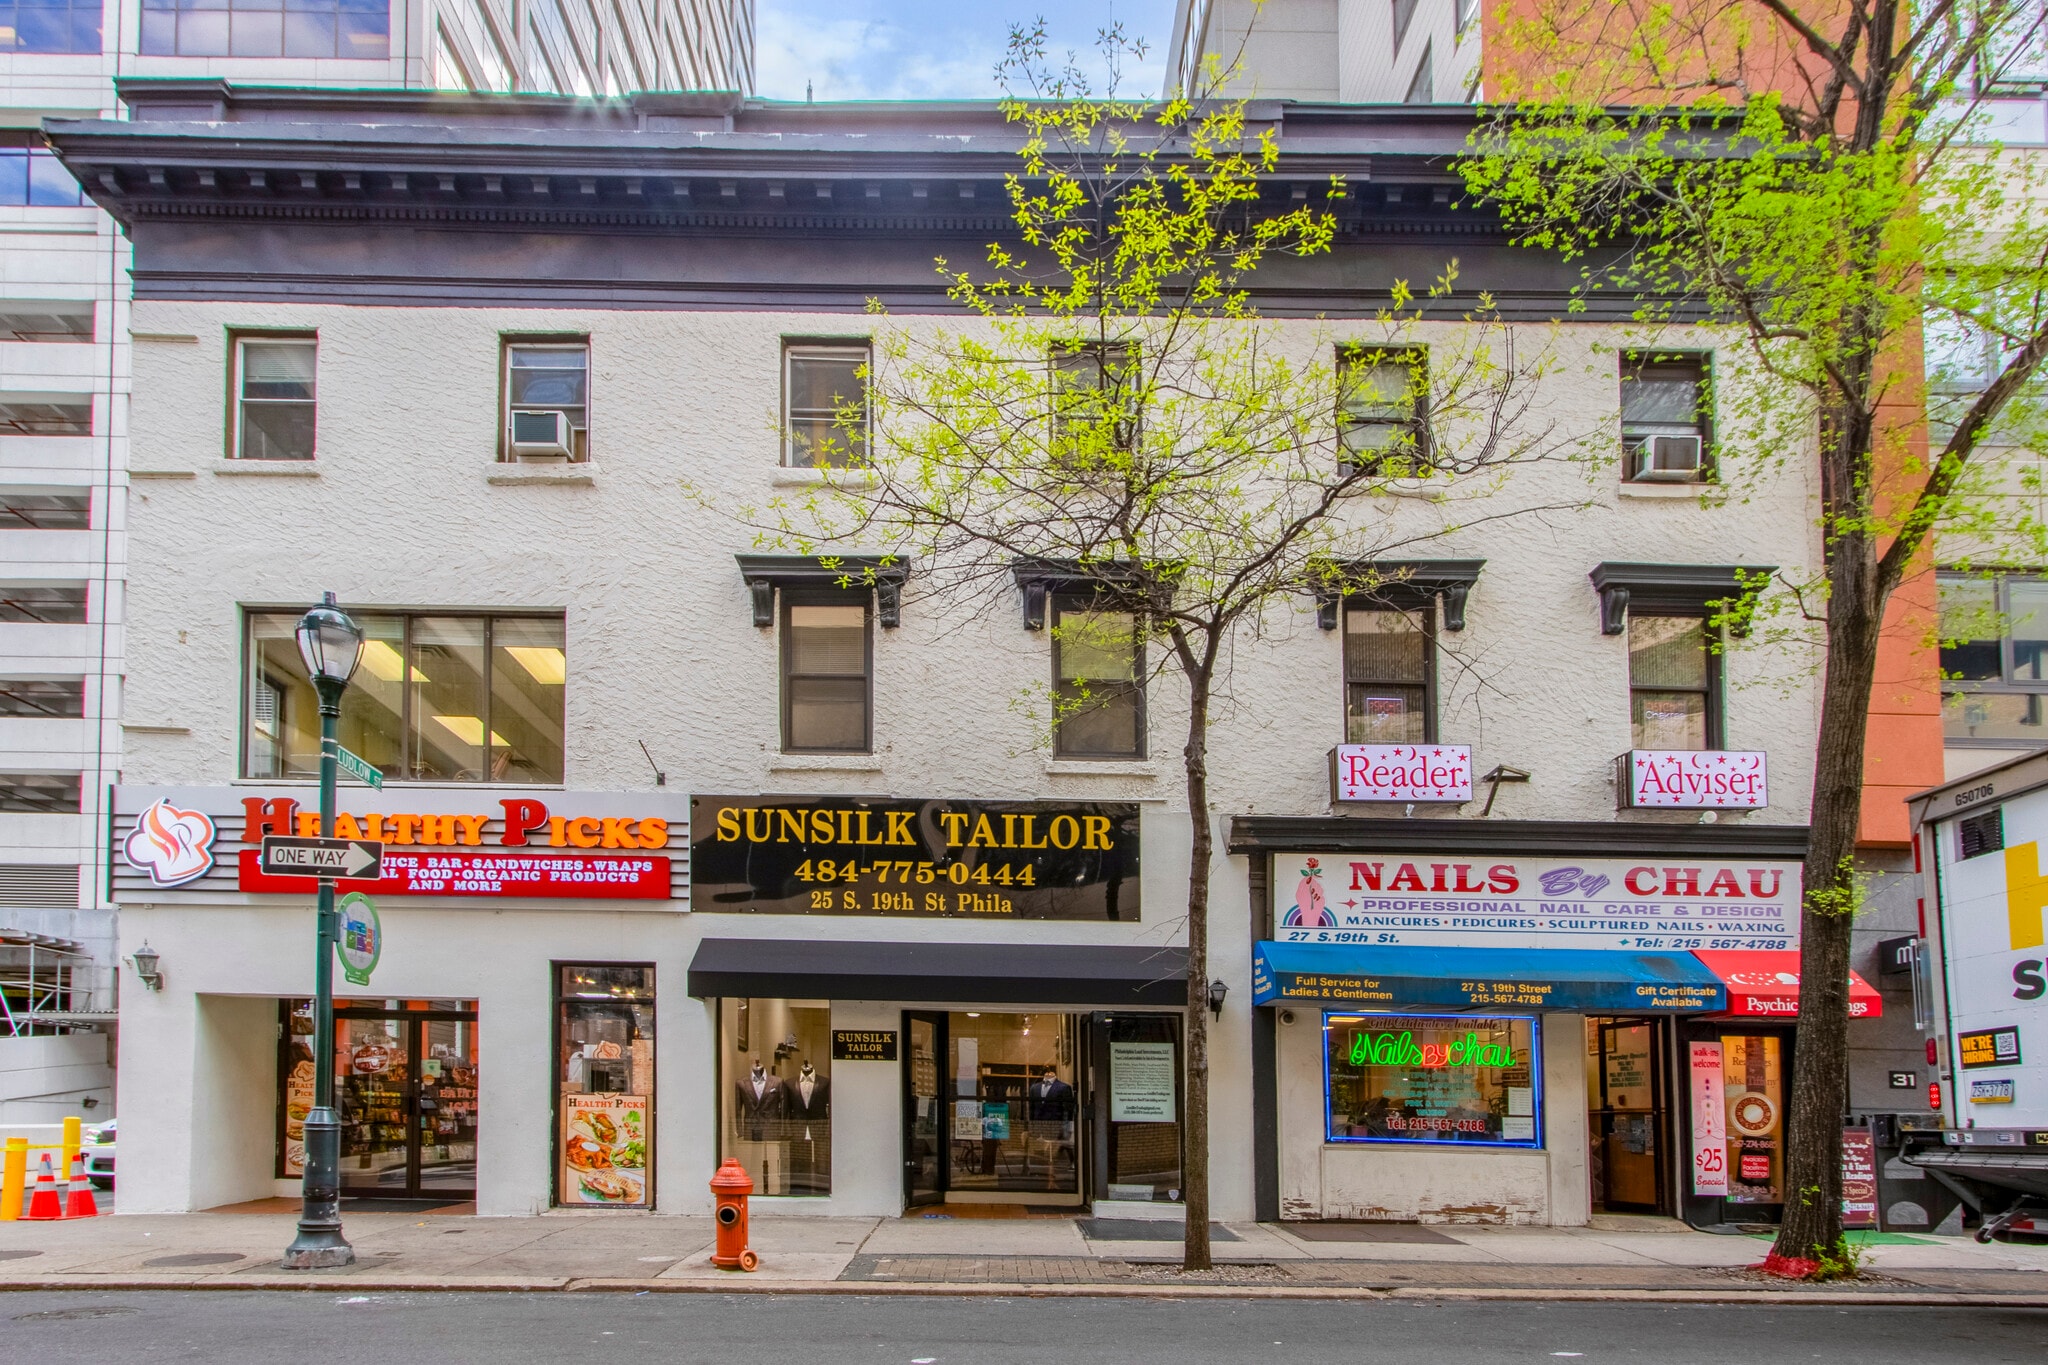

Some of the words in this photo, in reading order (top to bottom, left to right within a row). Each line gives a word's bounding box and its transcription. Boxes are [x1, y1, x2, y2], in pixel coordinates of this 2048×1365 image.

[338, 748, 370, 781] LUDLOW
[373, 776, 381, 788] ST
[1347, 755, 1463, 788] Reader
[1639, 760, 1760, 795] Adviser
[1955, 783, 1994, 807] G50706
[241, 797, 489, 846] HEALTHY
[499, 798, 669, 849] PICKS
[716, 807, 917, 846] SUNSILK
[941, 812, 1114, 851] TAILOR
[275, 848, 306, 864] ONE
[313, 849, 347, 866] WAY
[427, 857, 462, 869] BAR
[472, 858, 584, 871] SANDWICHES
[592, 860, 653, 872] WRAPS
[407, 868, 453, 879] FOOD
[462, 869, 541, 881] ORGANIC
[549, 871, 640, 883] PRODUCTS
[794, 859, 1036, 886] 484-775-0444
[1349, 862, 1520, 894] NAILS
[1537, 866, 1610, 898] By
[1624, 866, 1784, 898] CHAU
[408, 879, 445, 890] AND
[453, 880, 502, 892] MORE
[811, 891, 833, 909] 25
[843, 891, 861, 910] S.
[872, 892, 914, 911] 19th
[925, 892, 947, 911] St
[957, 893, 1013, 913] Phila
[1363, 899, 1526, 913] PROFESSIONAL
[1540, 903, 1590, 914] NAIL
[1604, 904, 1661, 915] CARE
[1673, 905, 1689, 916] &
[1701, 905, 1782, 917] DESIGN
[1346, 916, 1440, 927] MANICURES
[1452, 918, 1536, 928] PEDICURES
[1548, 919, 1649, 930] SCULPTURED
[1656, 921, 1704, 932] NAILS
[1717, 922, 1785, 933] WAXING
[1288, 931, 1310, 941] 27
[1377, 933, 1400, 943] St.
[1634, 937, 1664, 948] Tel:
[1667, 938, 1706, 949] (215)
[1709, 938, 1787, 950] 567-4788
[1296, 976, 1317, 986] Full
[1320, 977, 1361, 988] Service
[1364, 978, 1380, 988] for
[1461, 982, 1473, 992] 27
[1477, 983, 1488, 993] S.
[1492, 983, 1515, 993] 19th
[1520, 984, 1552, 994] Street
[1282, 986, 1319, 997] Ladies
[1322, 987, 1330, 997] &
[1333, 988, 1393, 1000] Gentlemen
[1471, 993, 1543, 1004] 215-567-4788
[1636, 986, 1656, 996] Gift
[1659, 986, 1717, 997] Certificate
[1651, 997, 1703, 1007] Available
[1747, 997, 1799, 1014] Psychic
[837, 1033, 892, 1043] SUNSILK
[1960, 1034, 1993, 1052] WE'RE
[847, 1044, 883, 1052] TAILOR
[1448, 1031, 1516, 1067] Chau
[1693, 1047, 1720, 1057] walk-ins
[1693, 1059, 1720, 1069] welcome
[1962, 1049, 1995, 1064] HIRING
[288, 1081, 314, 1089] HEALT
[1893, 1073, 1915, 1086] 31
[294, 1088, 314, 1097] PICK
[568, 1097, 614, 1108] HEALTHY
[615, 1098, 645, 1109] PICKS
[1387, 1117, 1407, 1130] Tel:
[1409, 1117, 1485, 1132] 215-567-4788
[1695, 1148, 1723, 1172] $25
[1695, 1175, 1726, 1189] Special
